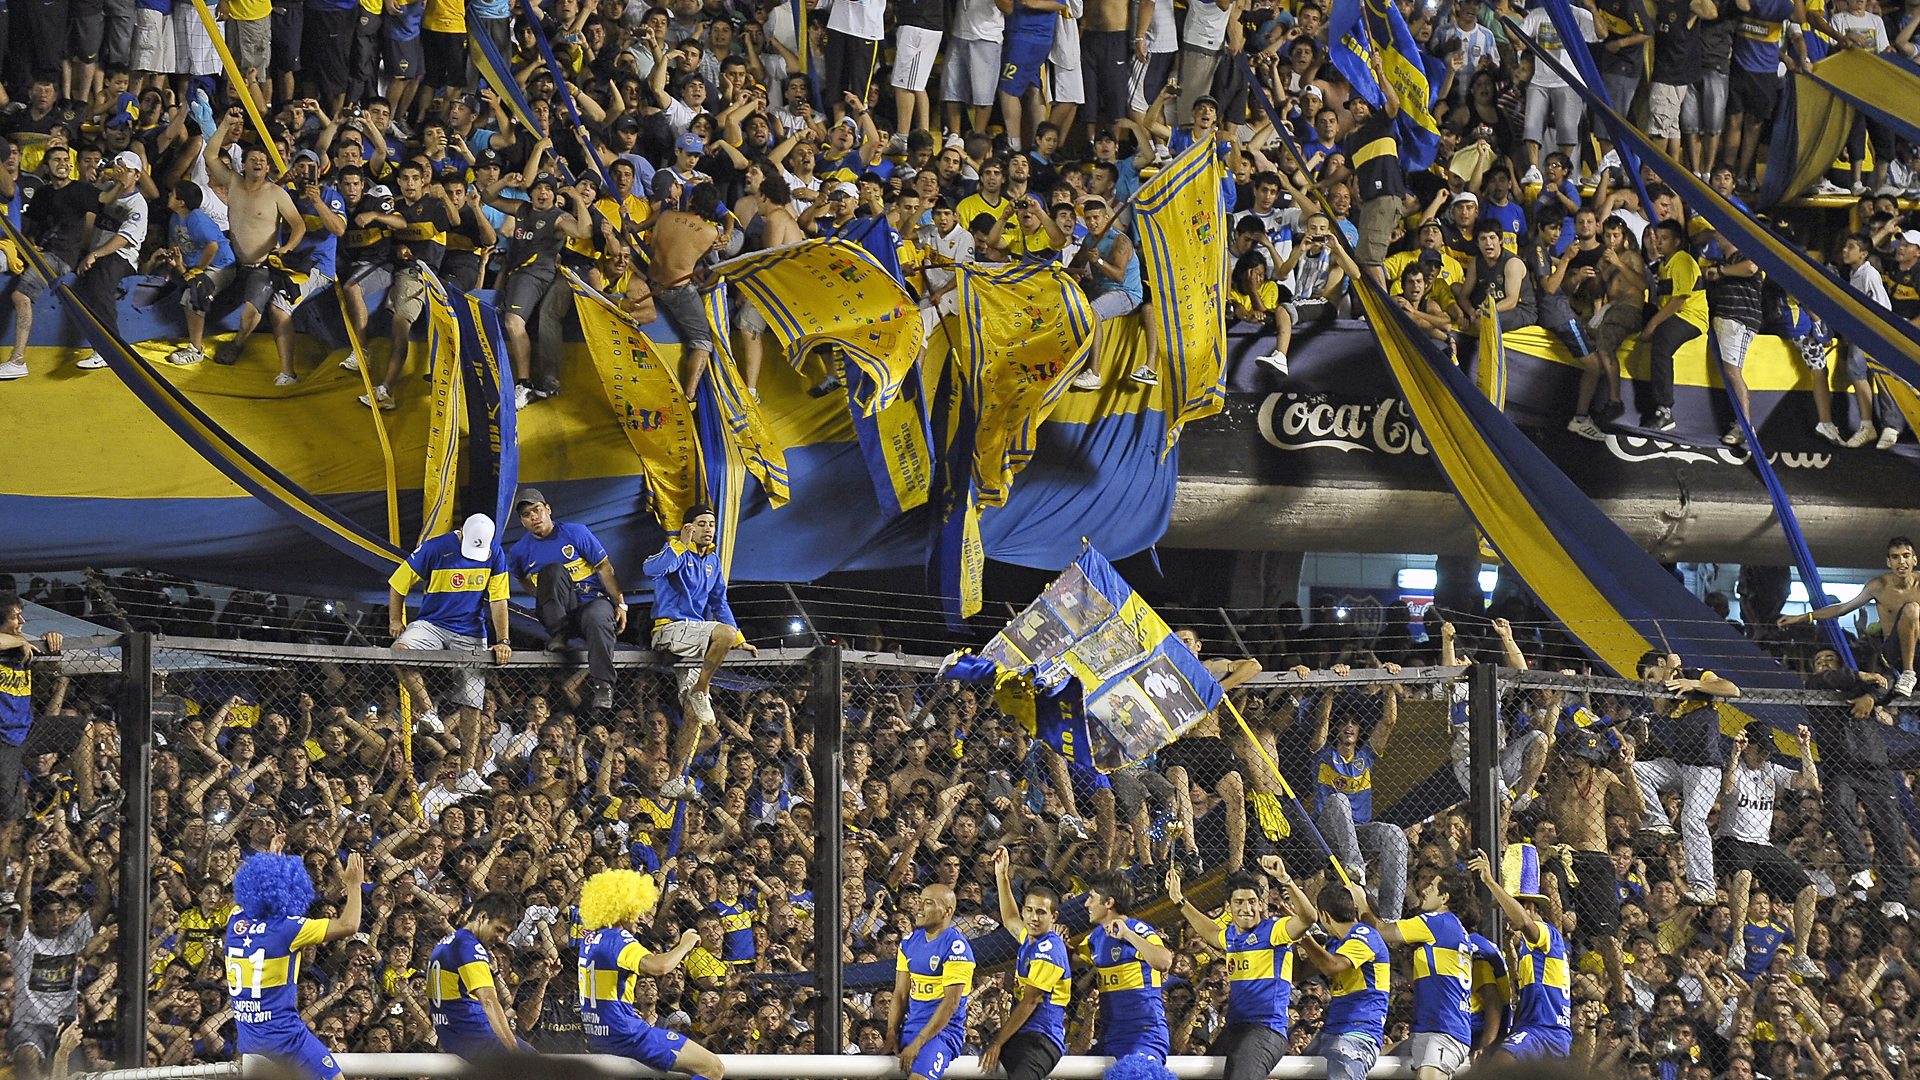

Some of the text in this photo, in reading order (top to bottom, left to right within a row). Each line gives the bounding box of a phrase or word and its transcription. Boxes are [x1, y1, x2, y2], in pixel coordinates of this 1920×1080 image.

[1003, 63, 1017, 80] 12
[522, 231, 533, 240] LG
[609, 320, 622, 356] PERO
[891, 433, 902, 451] LOS
[467, 575, 485, 585] LG
[1062, 700, 1073, 721] 12
[1737, 796, 1774, 811] bwin
[248, 923, 267, 935] LG
[949, 954, 968, 962] TOTAL
[1034, 952, 1053, 961] TOTAL
[1237, 959, 1249, 971] LG
[1457, 942, 1472, 991] 5
[227, 946, 266, 999] 51
[1103, 974, 1119, 986] LG
[918, 983, 934, 994] LG
[254, 1010, 272, 1024] 2011
[1437, 1047, 1445, 1064] 1
